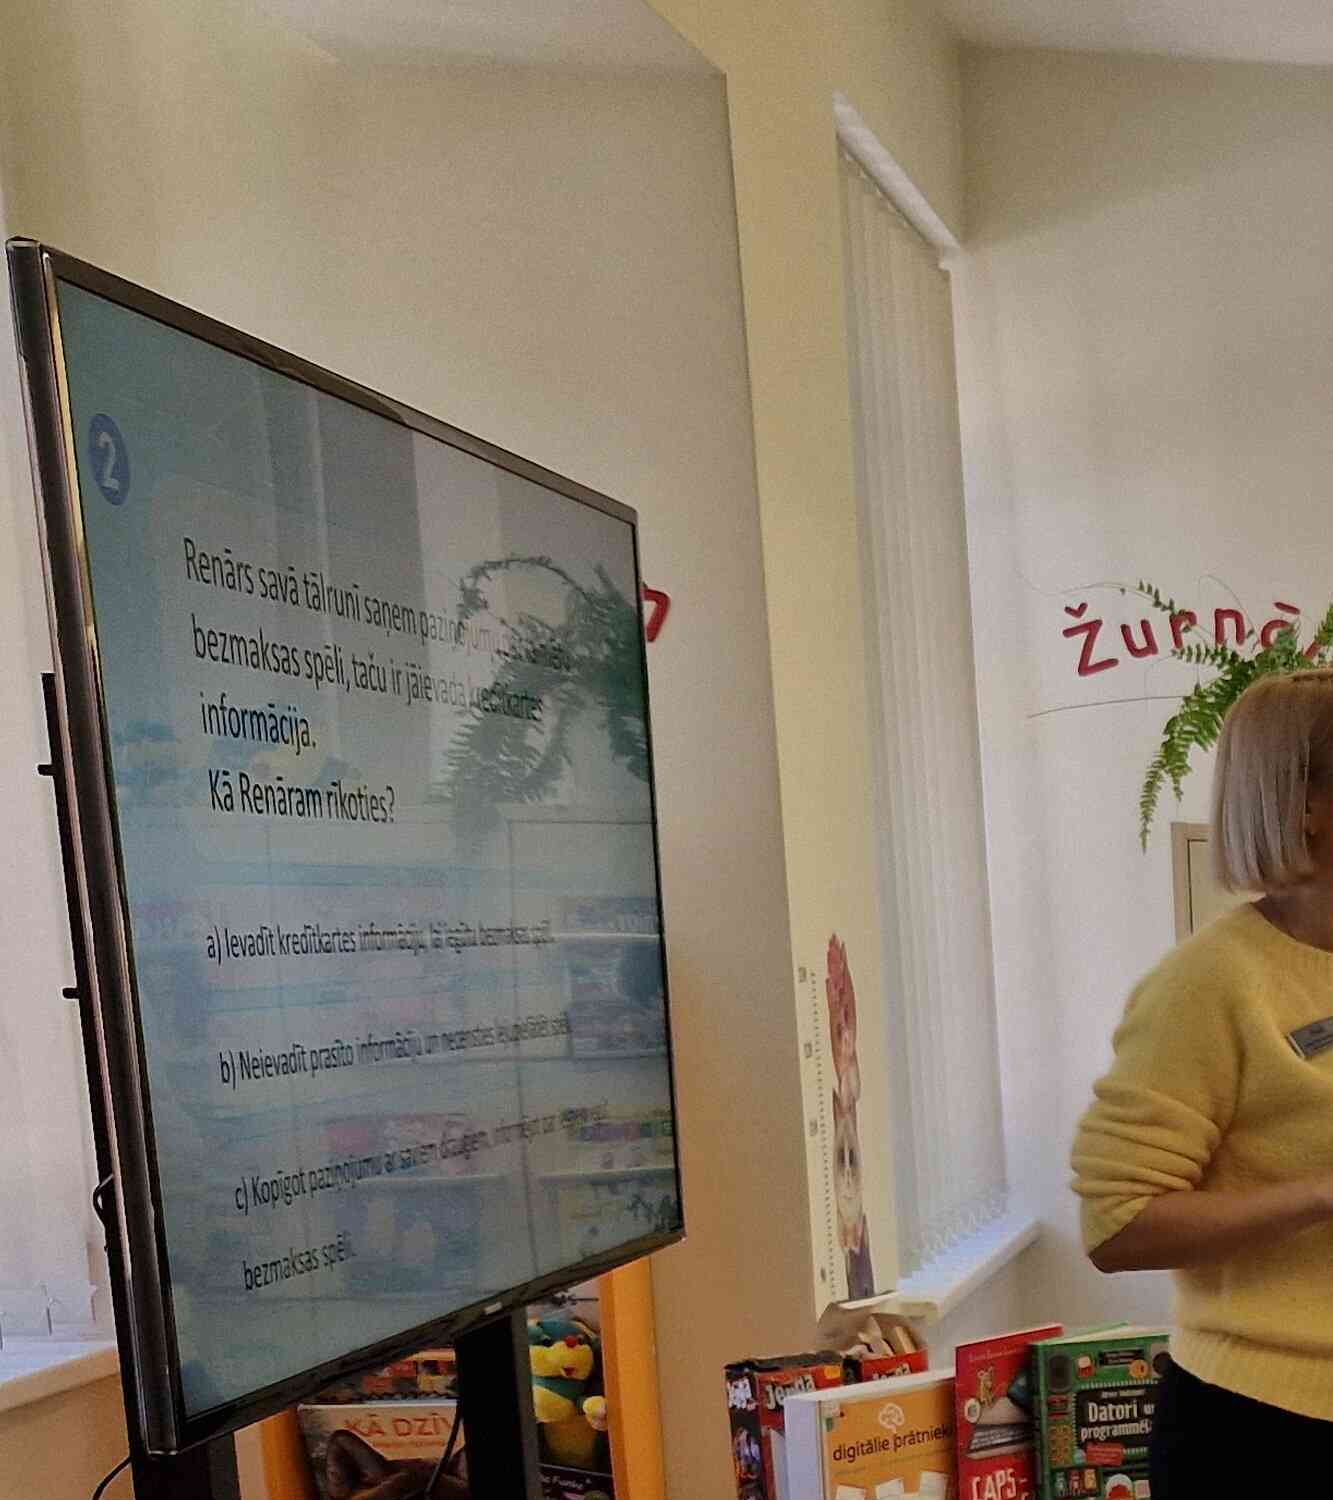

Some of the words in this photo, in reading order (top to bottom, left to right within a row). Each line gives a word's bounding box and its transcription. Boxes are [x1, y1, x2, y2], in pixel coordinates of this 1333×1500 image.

[95, 431, 121, 492] 2
[183, 537, 255, 596] Renārs
[258, 565, 301, 606] savā
[303, 571, 361, 623] tālrunī
[364, 596, 418, 638] saņem
[191, 612, 301, 678] bezmaksas
[303, 644, 351, 693] spēli,
[351, 652, 387, 693] taču
[390, 658, 402, 697] ir
[1062, 601, 1326, 678] Žurnā
[200, 692, 317, 756] informācija.
[208, 769, 235, 813] Kā
[238, 772, 323, 819] Renāram
[324, 780, 395, 823] rīkoties?
[206, 925, 222, 966] a)
[219, 1050, 236, 1091] b)
[234, 1176, 248, 1216] c)
[243, 1248, 320, 1292] bezmaksas
[1087, 1400, 1138, 1423] Datori
[832, 1435, 890, 1464] digitālie
